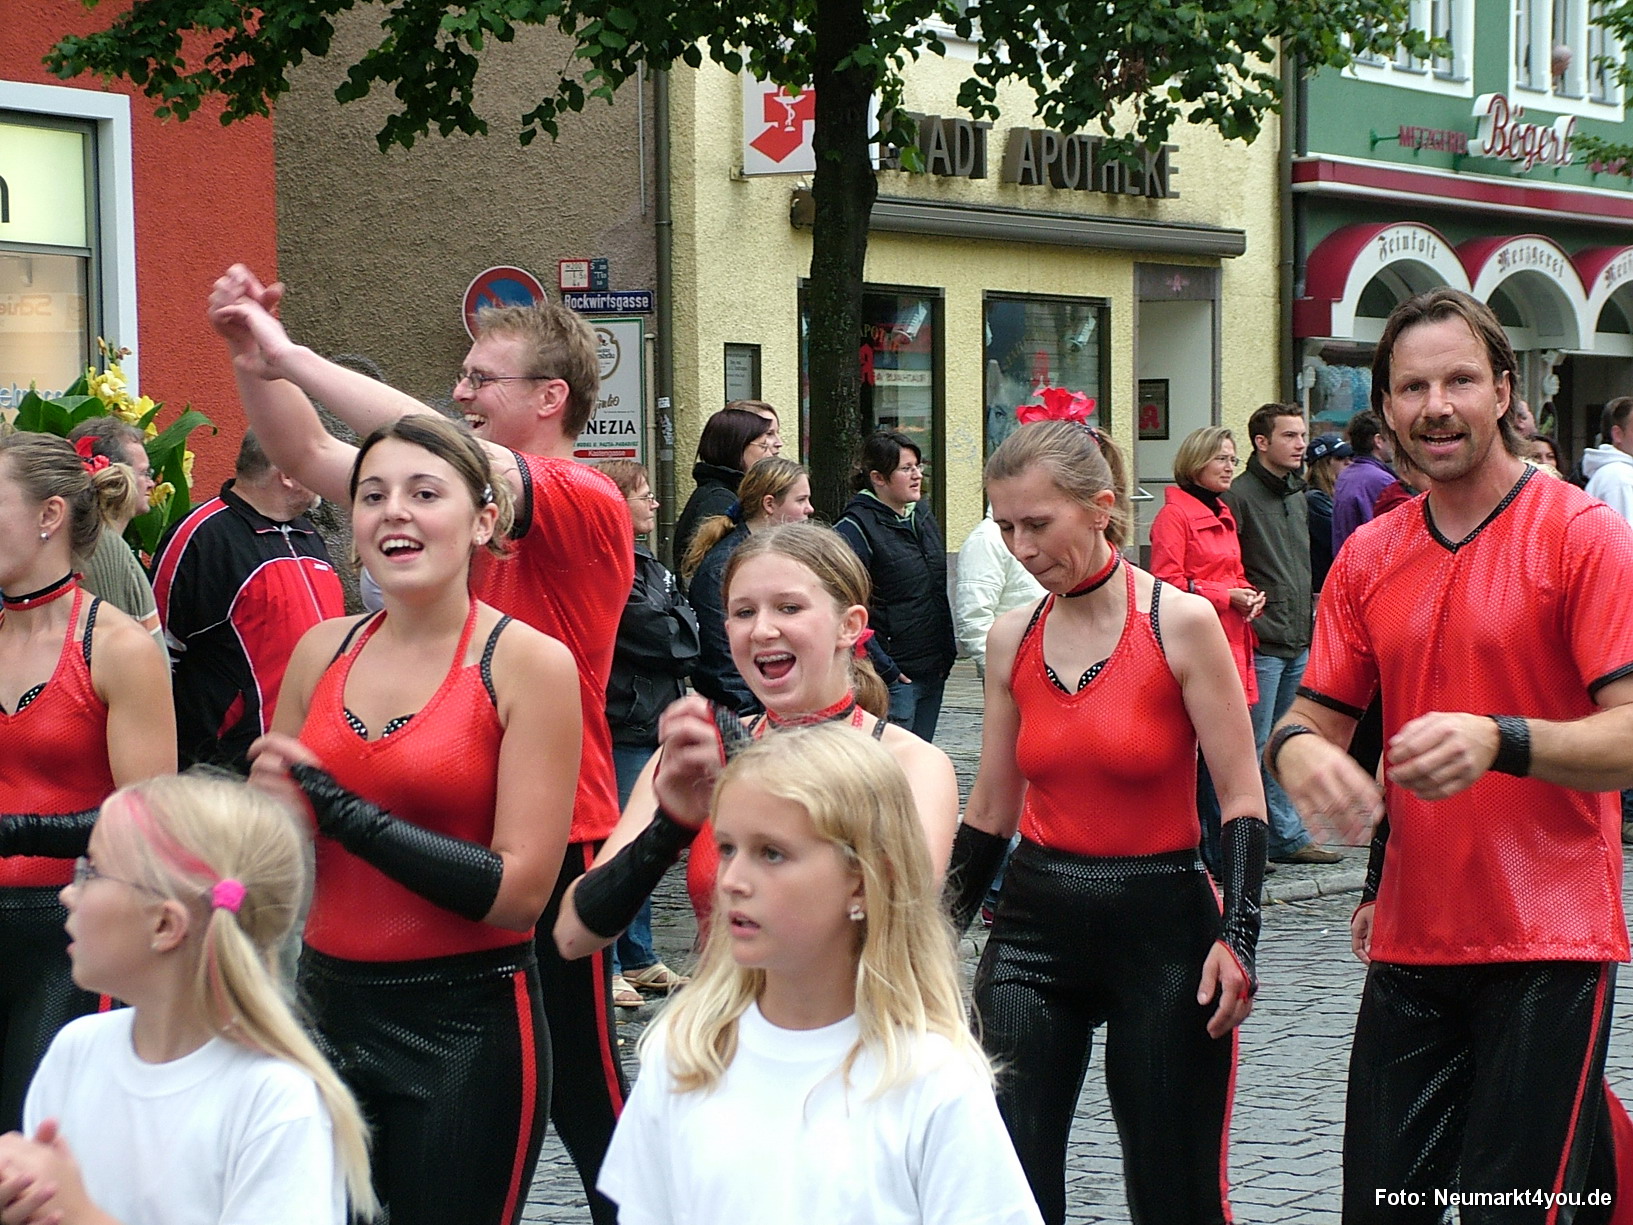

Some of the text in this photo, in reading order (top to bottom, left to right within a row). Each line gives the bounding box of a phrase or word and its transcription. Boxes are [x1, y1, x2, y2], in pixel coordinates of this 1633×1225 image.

[1471, 93, 1577, 173] Bögerl
[564, 293, 650, 311] Bockwirtsgasse
[580, 420, 637, 435] NEZIA
